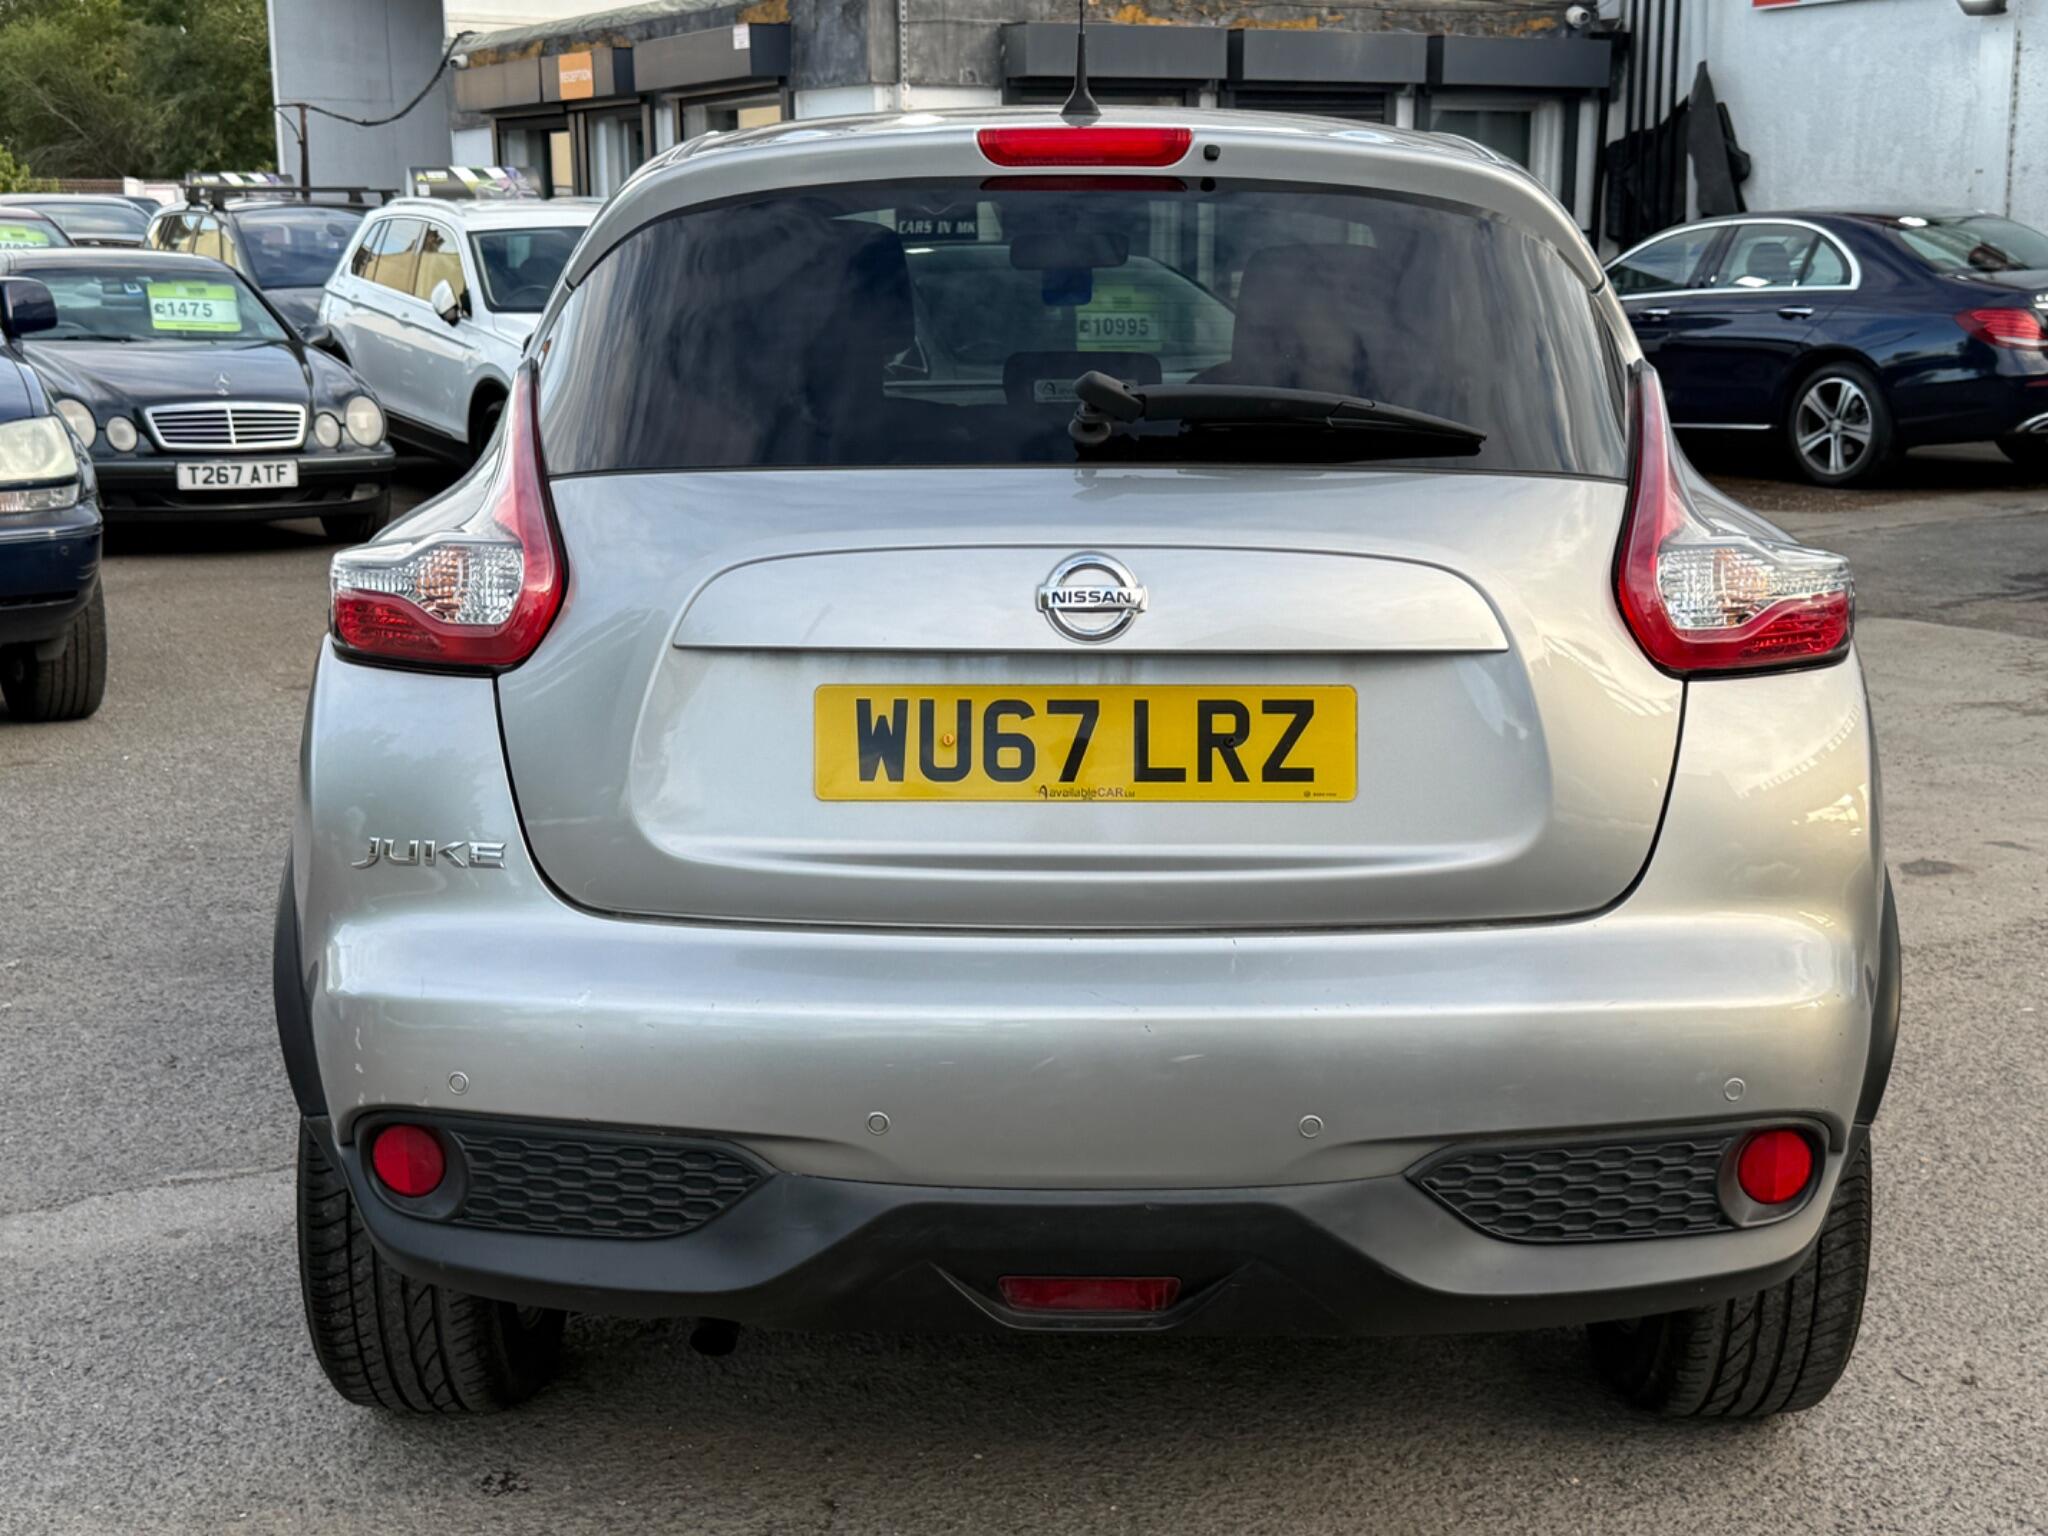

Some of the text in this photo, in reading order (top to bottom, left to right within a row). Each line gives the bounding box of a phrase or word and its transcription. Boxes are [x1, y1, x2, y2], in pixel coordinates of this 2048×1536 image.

[898, 220, 976, 235] CARS IN MK
[187, 464, 288, 485] T267 ATF
[1051, 590, 1132, 604] NISSAN
[855, 699, 1315, 783] WU67 LRZ
[351, 836, 507, 869] JUKE
